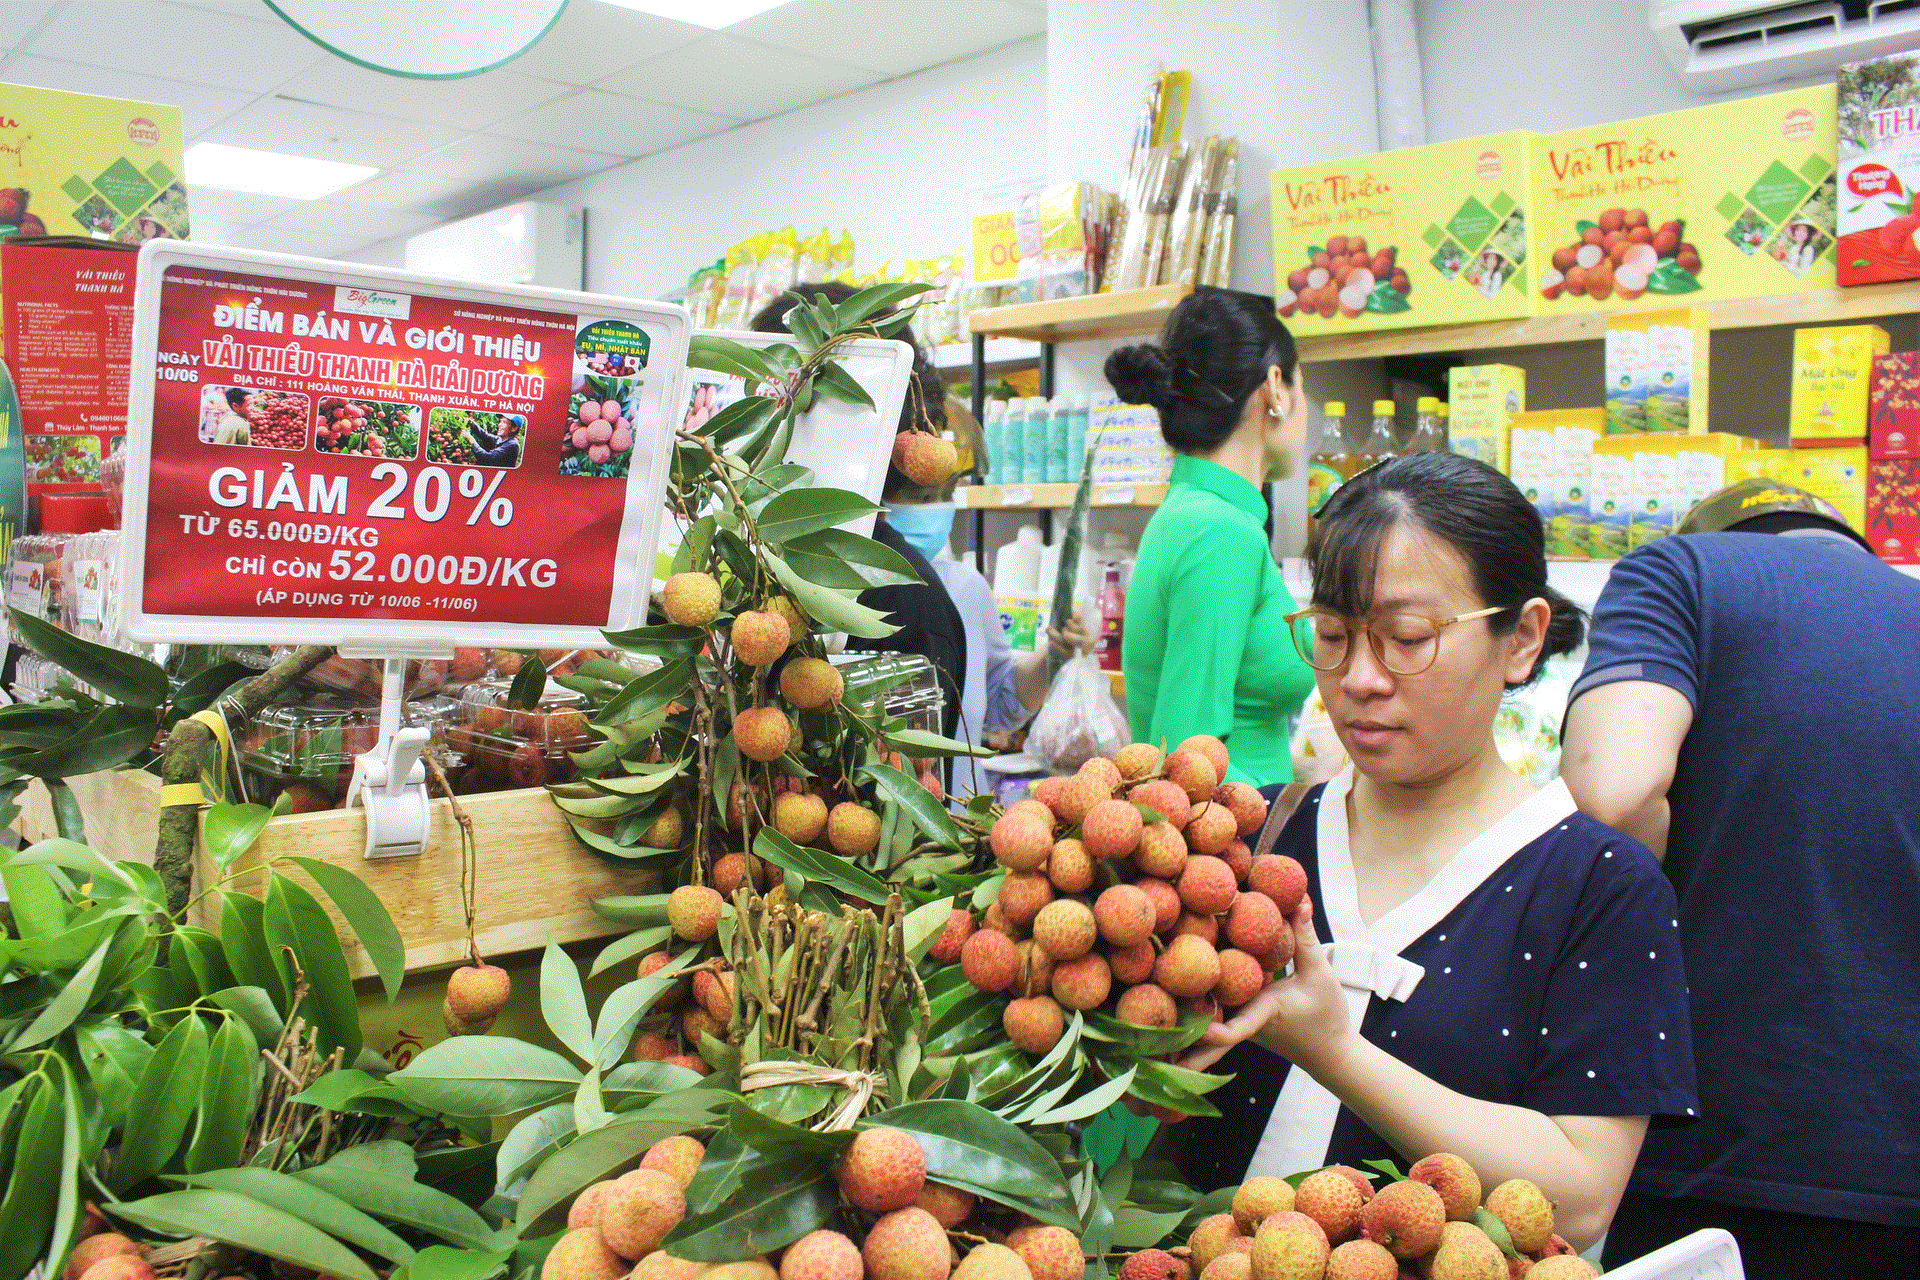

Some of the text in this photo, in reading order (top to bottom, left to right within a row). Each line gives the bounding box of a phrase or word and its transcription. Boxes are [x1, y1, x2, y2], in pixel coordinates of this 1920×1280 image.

[213, 297, 541, 367] ĐIỂM BÁN VÀ GIỚI THIỆU
[609, 344, 629, 355] NHẬT
[157, 367, 199, 383] 10/06
[158, 351, 201, 366] NGÀY
[203, 334, 544, 401] VẢI THIỀU THANH HÀ HẢI DƯƠNG
[233, 373, 253, 386] ĐỊA
[287, 380, 304, 390] 111
[307, 380, 348, 395] HOÀNG
[351, 383, 375, 397] VĂN
[409, 391, 445, 404] THANH
[484, 398, 497, 409] TP
[499, 399, 513, 411] HÀ
[516, 401, 535, 414] NỘI
[208, 462, 514, 527] GIẢM 20%
[178, 511, 379, 547] TỪ 65.000Đ/KG
[225, 550, 558, 588] CHỈ CÒN 52.000Đ/KG
[256, 588, 478, 613] (ÁP DỤNG TỪ 10/06 -11/06)
